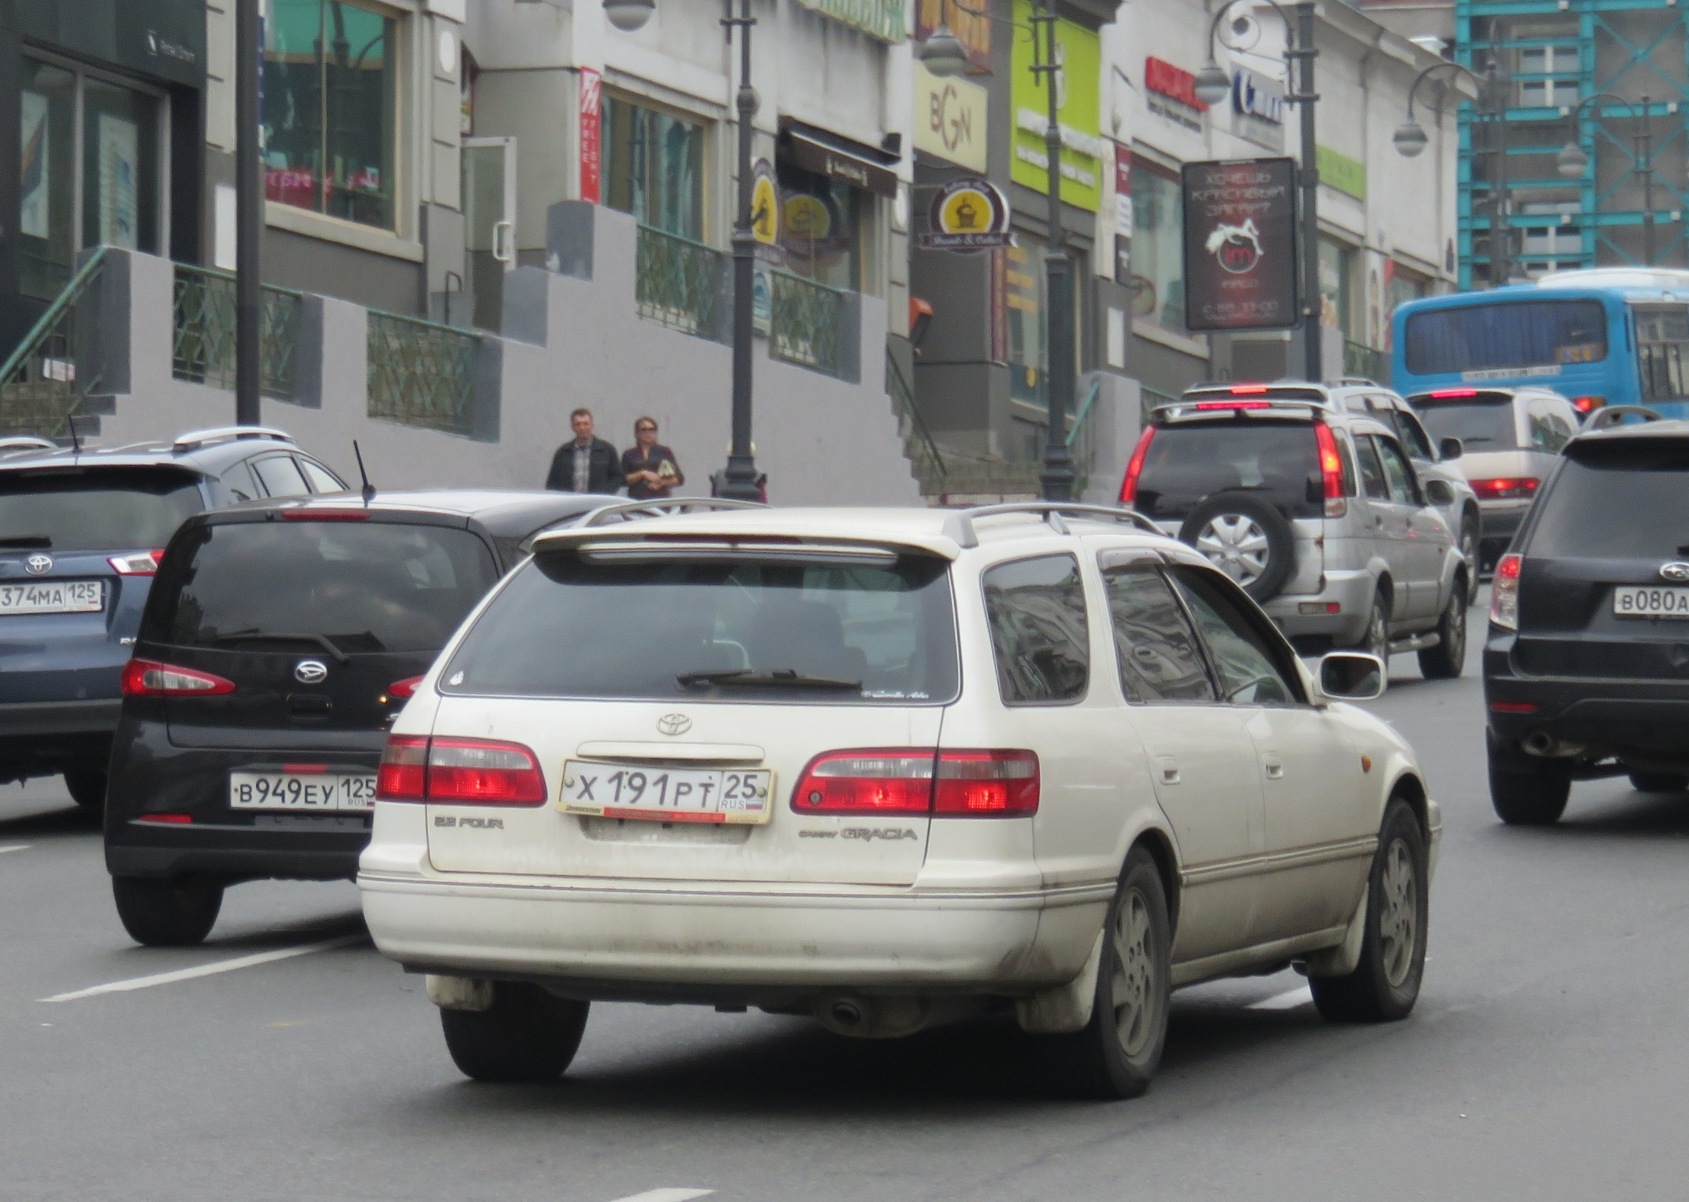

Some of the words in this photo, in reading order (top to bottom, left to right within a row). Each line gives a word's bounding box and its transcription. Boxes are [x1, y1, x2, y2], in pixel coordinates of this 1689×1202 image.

[930, 84, 972, 151] BGN
[68, 584, 96, 600] 125
[1621, 590, 1688, 611] В080А
[239, 777, 334, 804] В949ЕУ
[341, 778, 376, 798] 125
[723, 774, 758, 800] 25
[720, 800, 745, 810] RUS
[459, 817, 504, 830] FOUR
[840, 827, 918, 842] GRACIA
